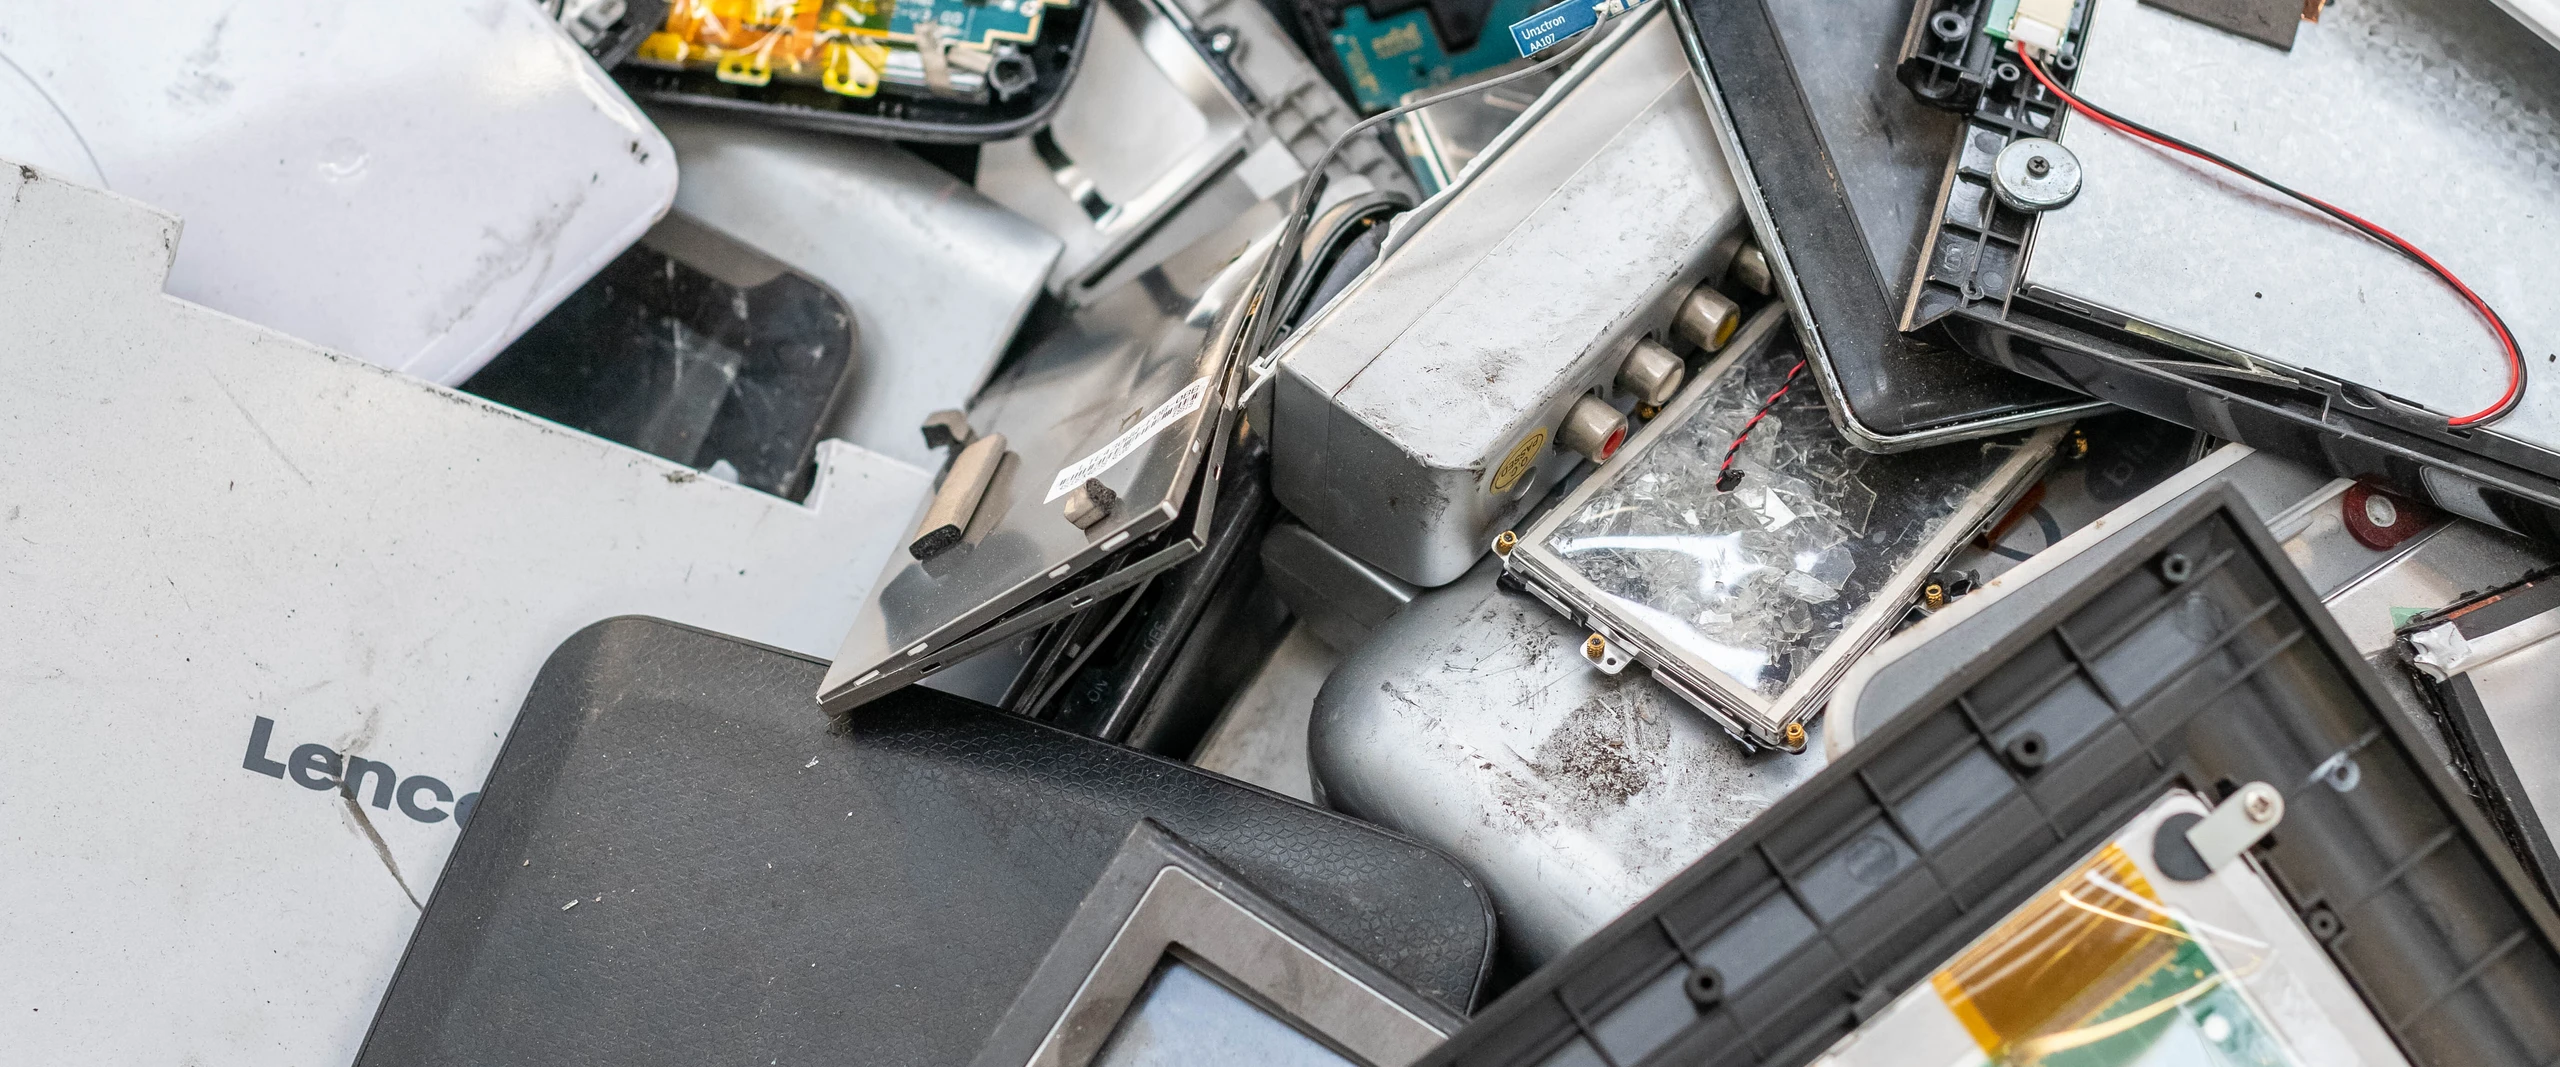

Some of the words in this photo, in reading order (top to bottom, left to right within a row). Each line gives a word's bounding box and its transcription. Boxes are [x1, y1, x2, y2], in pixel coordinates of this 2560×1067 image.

[1530, 33, 1555, 52] AA107
[1500, 435, 1539, 478] PASSED
[1086, 680, 1109, 703] ON
[242, 715, 481, 831] Lenc
